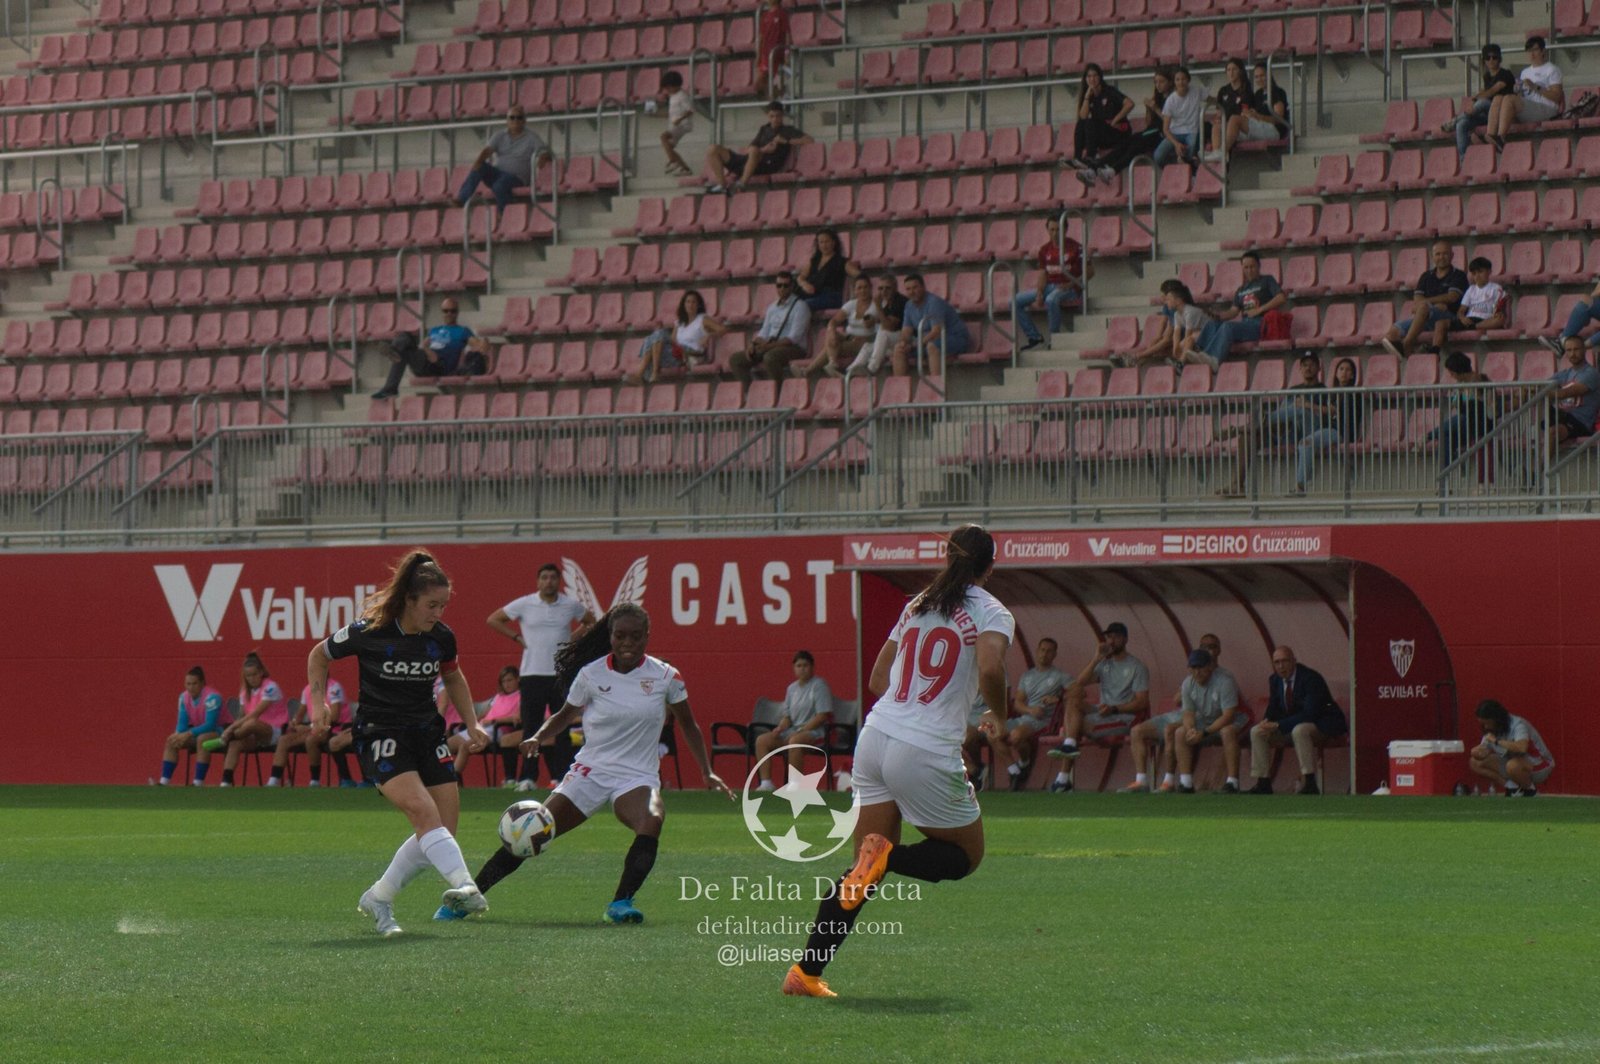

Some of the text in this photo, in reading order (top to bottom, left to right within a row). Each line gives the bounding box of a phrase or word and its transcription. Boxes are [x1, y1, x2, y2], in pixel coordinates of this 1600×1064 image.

[872, 547, 915, 560] Valvoline
[1004, 539, 1070, 560] Cruzcampo
[1109, 542, 1157, 557] Valvoline
[1184, 535, 1248, 554] DEGIRO
[1252, 534, 1321, 555] Cruzcampo
[671, 560, 857, 626] CAST
[240, 585, 376, 640] Valvoli
[950, 603, 978, 646] RIETO
[382, 660, 440, 675] CAZOO
[895, 626, 961, 705] 19
[1378, 685, 1429, 698] SEVILLA FC
[371, 738, 397, 762] 10
